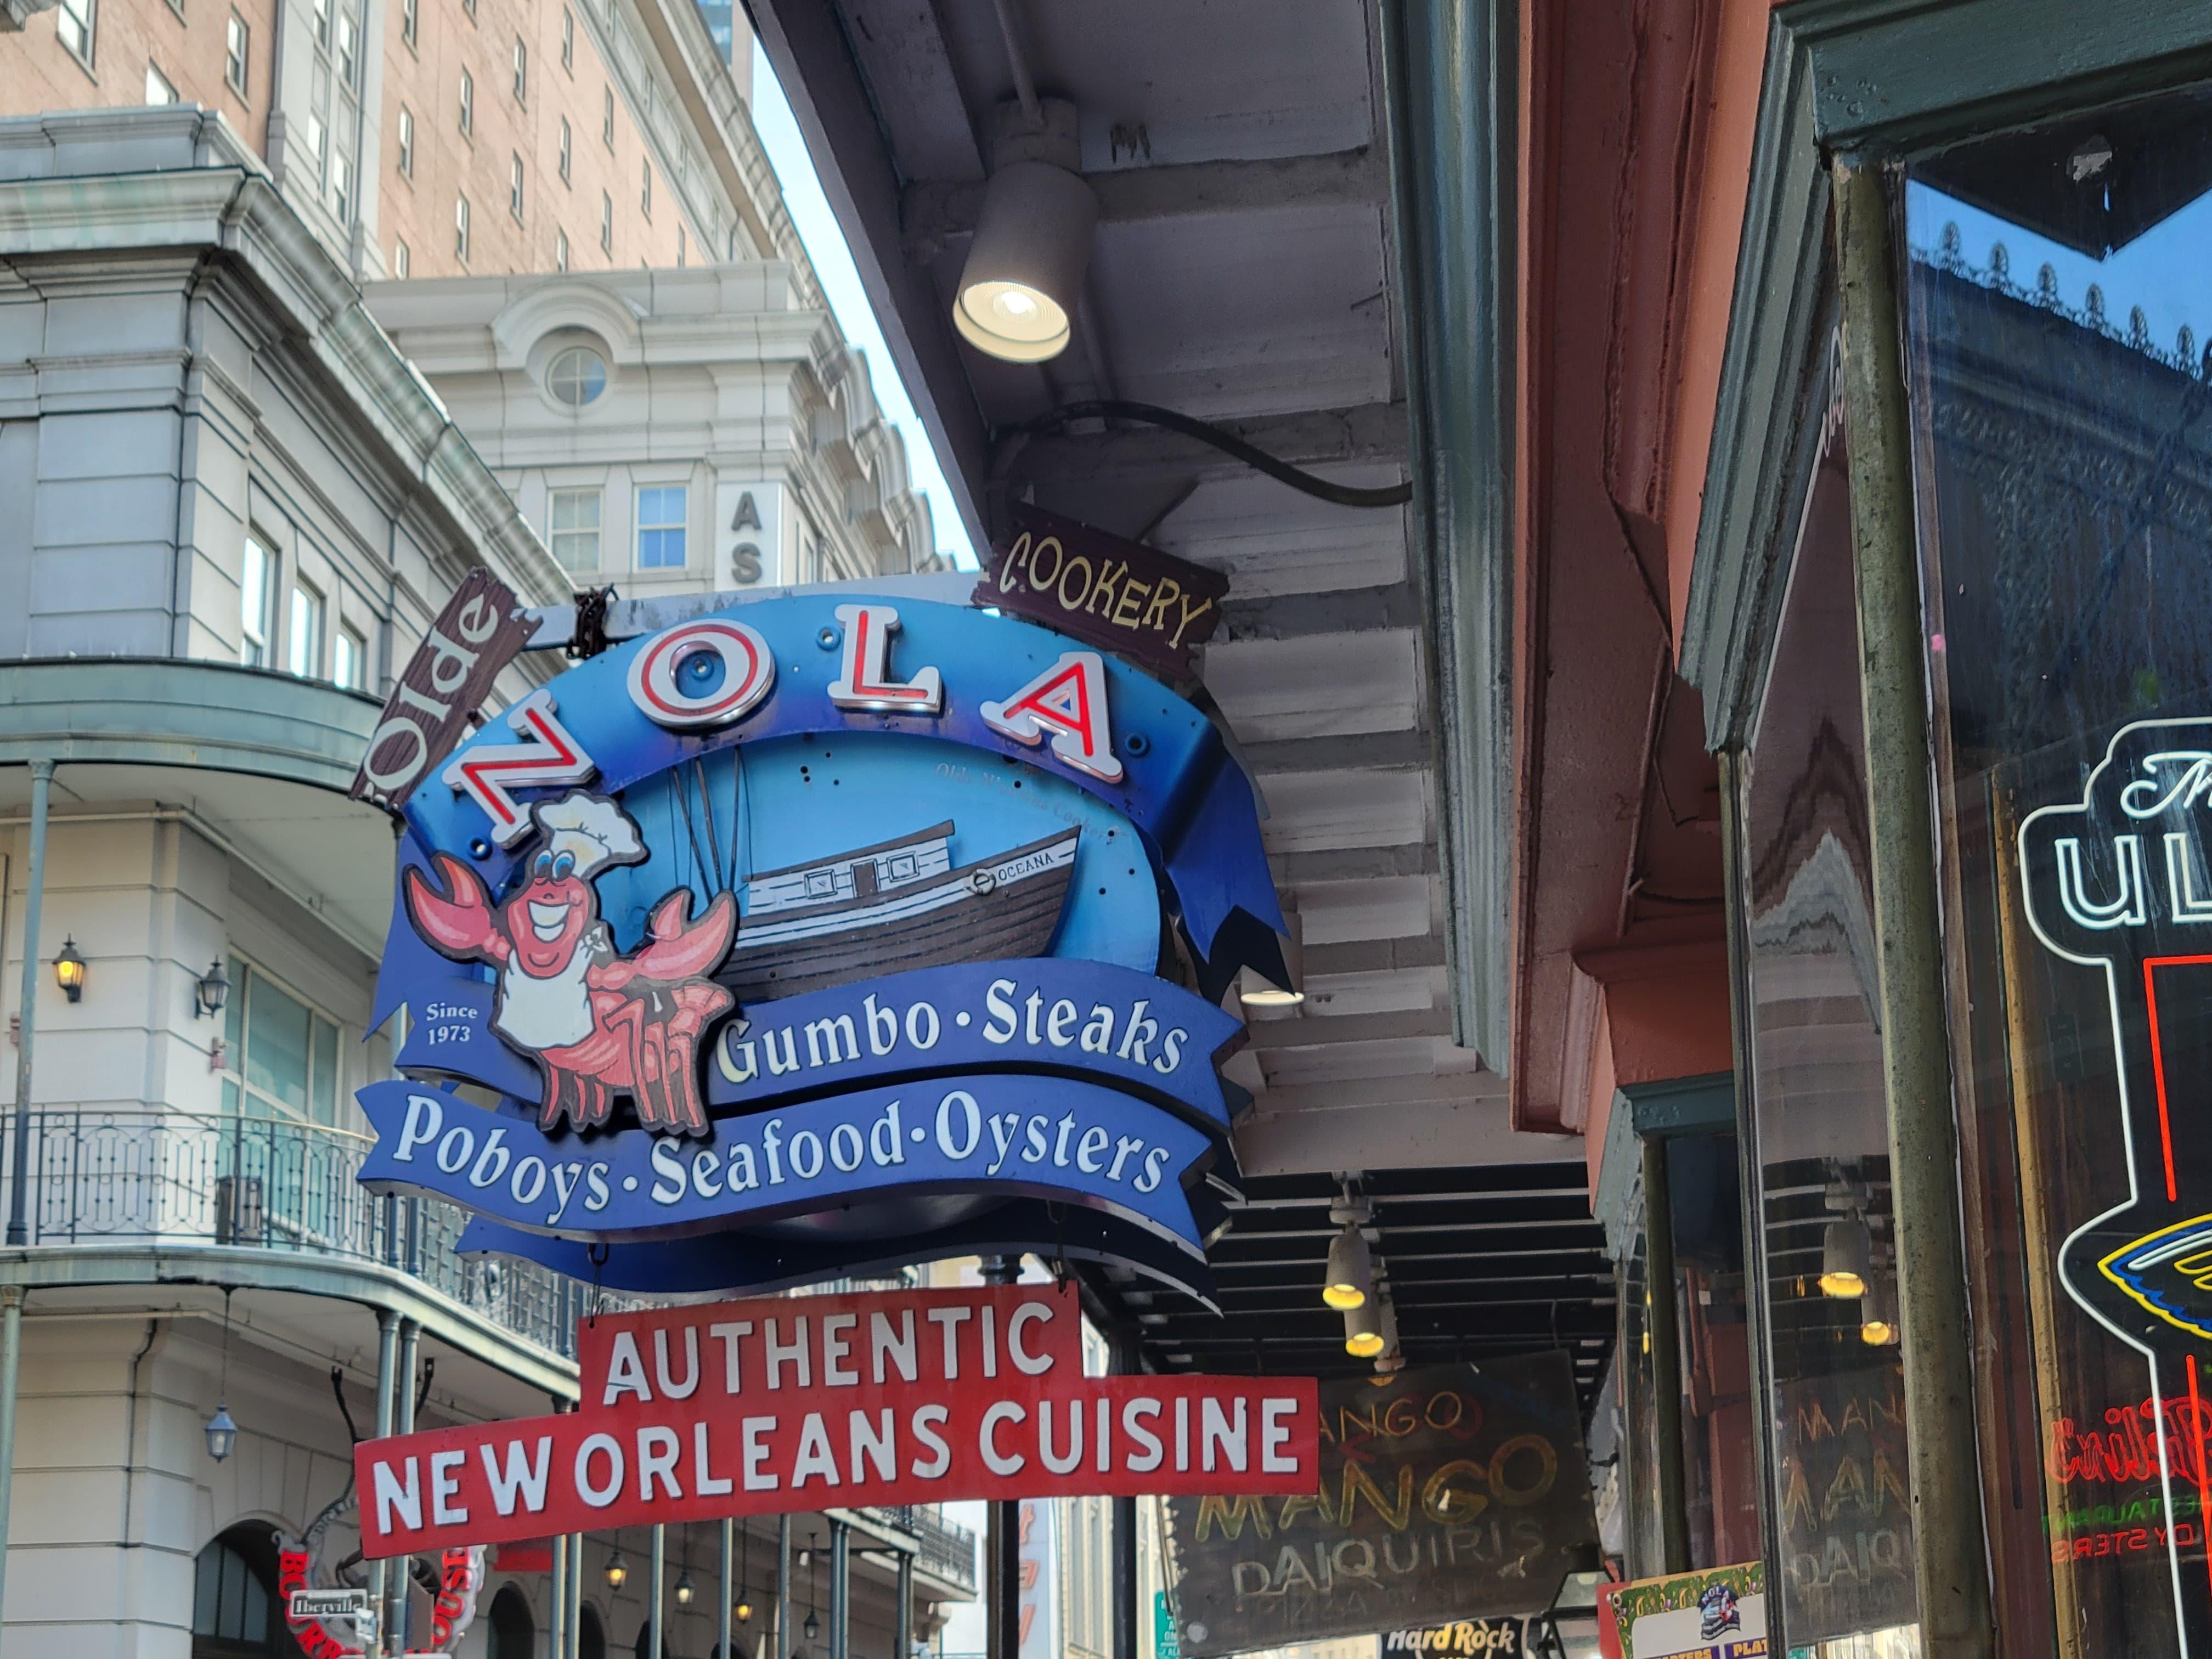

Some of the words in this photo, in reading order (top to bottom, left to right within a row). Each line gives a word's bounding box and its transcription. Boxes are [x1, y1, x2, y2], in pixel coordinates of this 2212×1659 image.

[999, 531, 1212, 648] COOKERY
[364, 593, 499, 790] Olde
[442, 603, 1123, 850] NOLA
[997, 853, 1054, 881] OCEANA
[426, 1002, 478, 1022] Since
[427, 1026, 471, 1045] 1973
[716, 994, 940, 1083] Gumbo
[982, 978, 1189, 1074] Steaks
[393, 1094, 610, 1224] Poboys
[650, 1100, 905, 1205] Seafood
[935, 1091, 1170, 1194] Oysters
[603, 1302, 1055, 1406] AUTHENTIC
[373, 1436, 552, 1535] NEW
[575, 1404, 951, 1508] ORLEANS
[979, 1396, 1298, 1476] CUISINE
[1387, 1623, 1453, 1651] Hard
[1454, 1622, 1515, 1655] Rock
